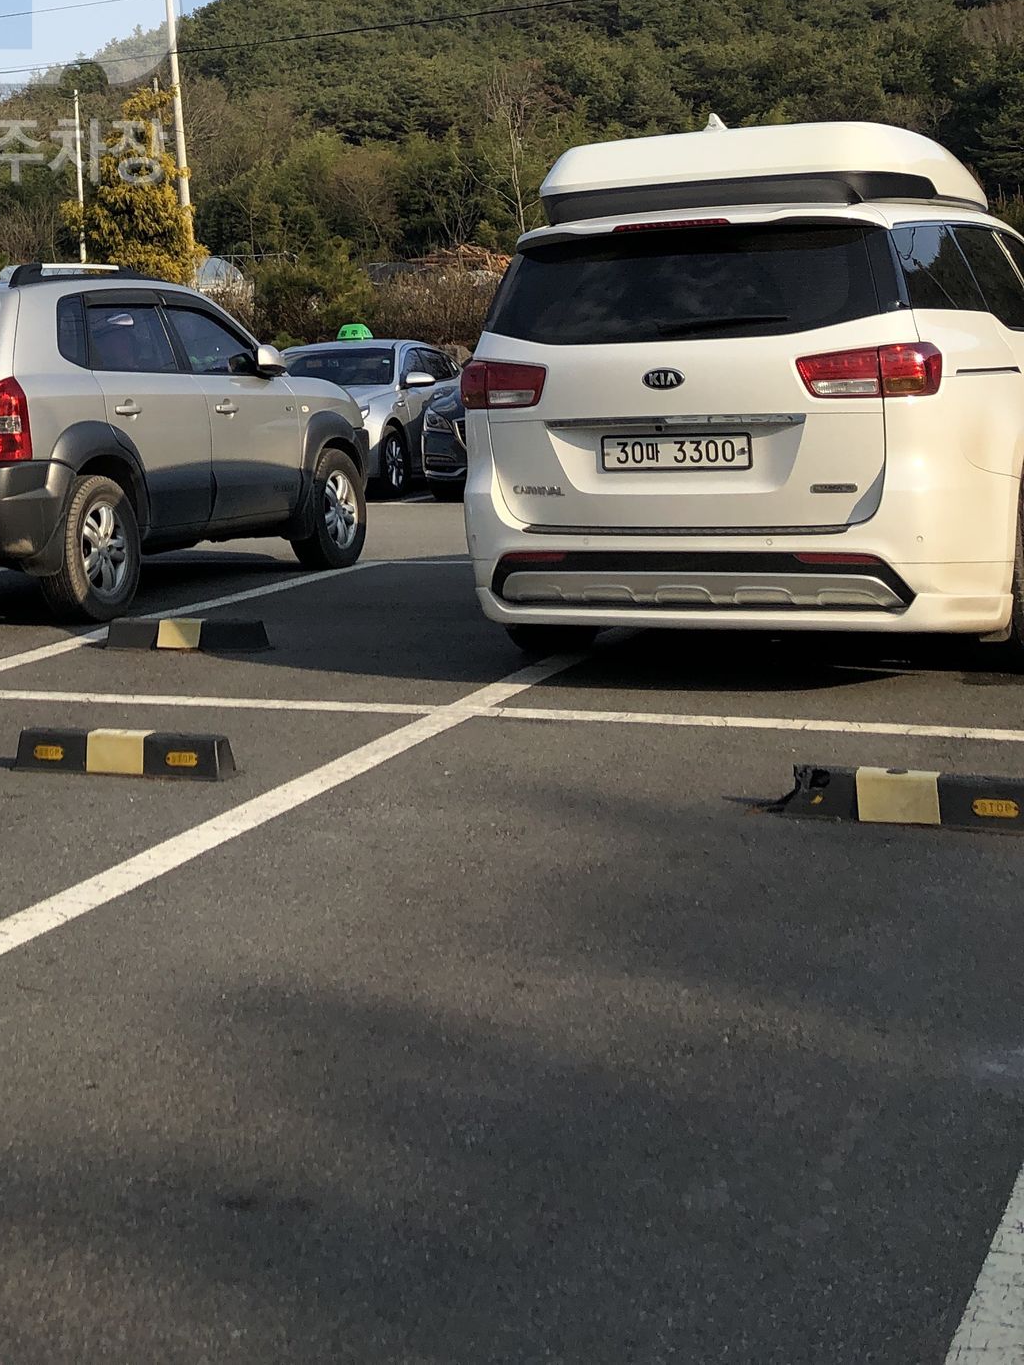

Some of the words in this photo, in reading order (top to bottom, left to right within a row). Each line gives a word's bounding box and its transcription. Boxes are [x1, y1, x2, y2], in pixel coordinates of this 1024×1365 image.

[648, 372, 677, 385] KIA
[616, 440, 661, 464] 30마
[673, 439, 735, 463] 3300
